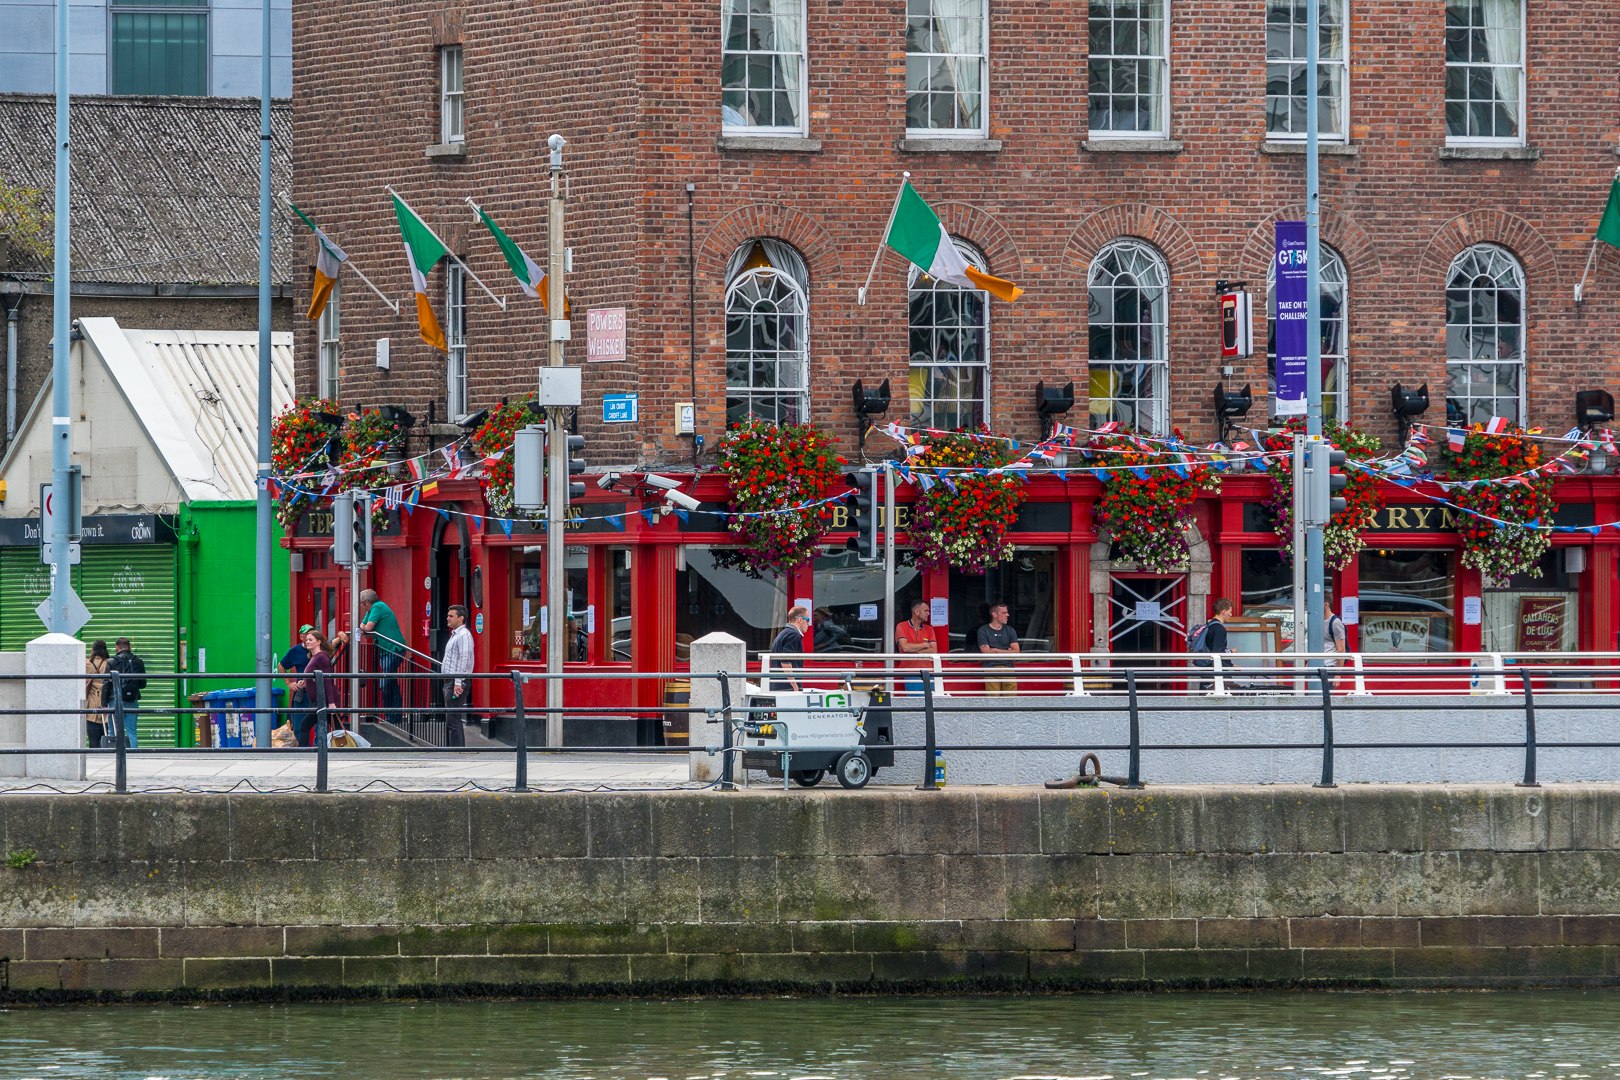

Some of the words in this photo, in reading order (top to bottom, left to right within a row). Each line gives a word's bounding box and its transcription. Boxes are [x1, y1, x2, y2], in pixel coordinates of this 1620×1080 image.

[1278, 301, 1292, 309] TAKE
[1293, 301, 1302, 309] ON
[588, 338, 625, 356] WHISKEY
[81, 526, 97, 538] rown
[131, 526, 152, 540] CROWN
[1365, 620, 1428, 638] GUINNESS
[1526, 625, 1536, 635] DE
[1537, 625, 1555, 636] LUXE
[806, 694, 852, 713] HGI
